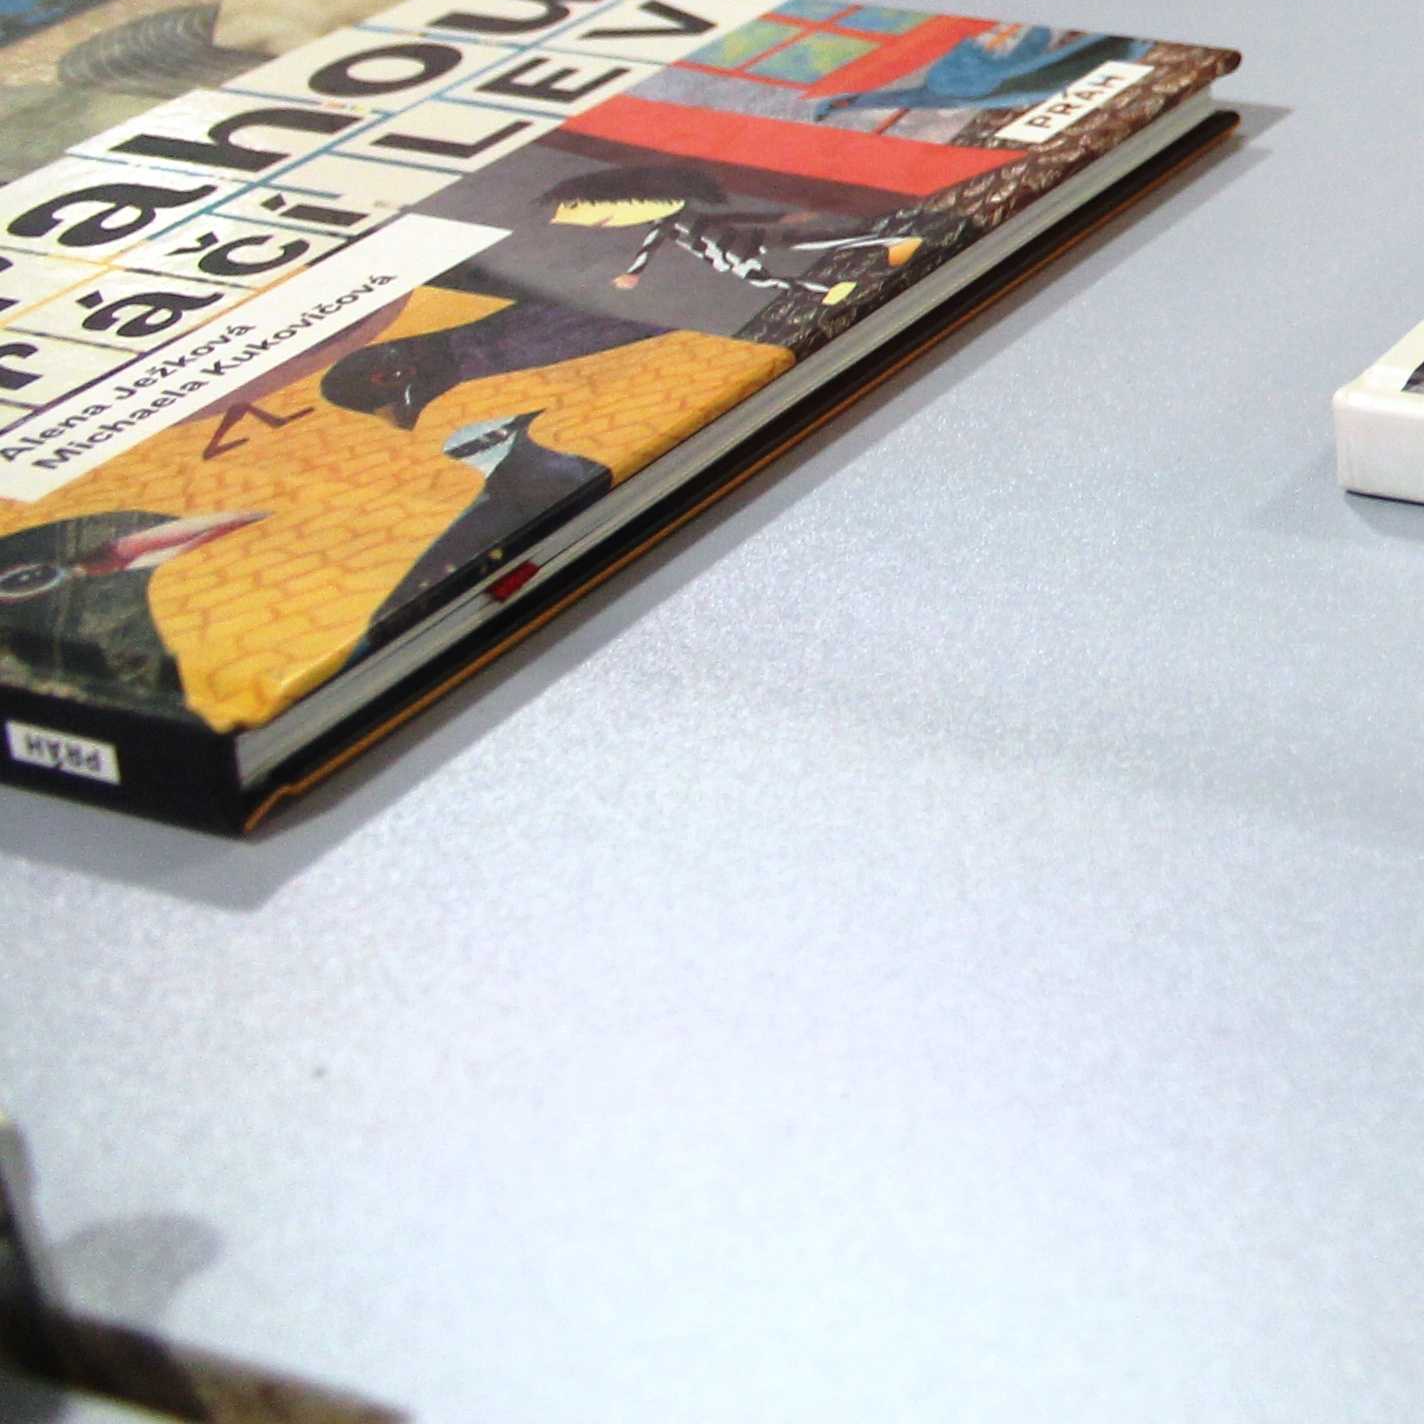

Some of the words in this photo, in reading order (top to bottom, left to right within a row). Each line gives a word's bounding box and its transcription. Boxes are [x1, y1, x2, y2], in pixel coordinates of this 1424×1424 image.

[369, 0, 718, 160] LEV
[0, 404, 110, 462] Alena
[115, 321, 257, 400] Ježková
[32, 380, 209, 470] Michaela
[200, 273, 398, 376] Kukovičová
